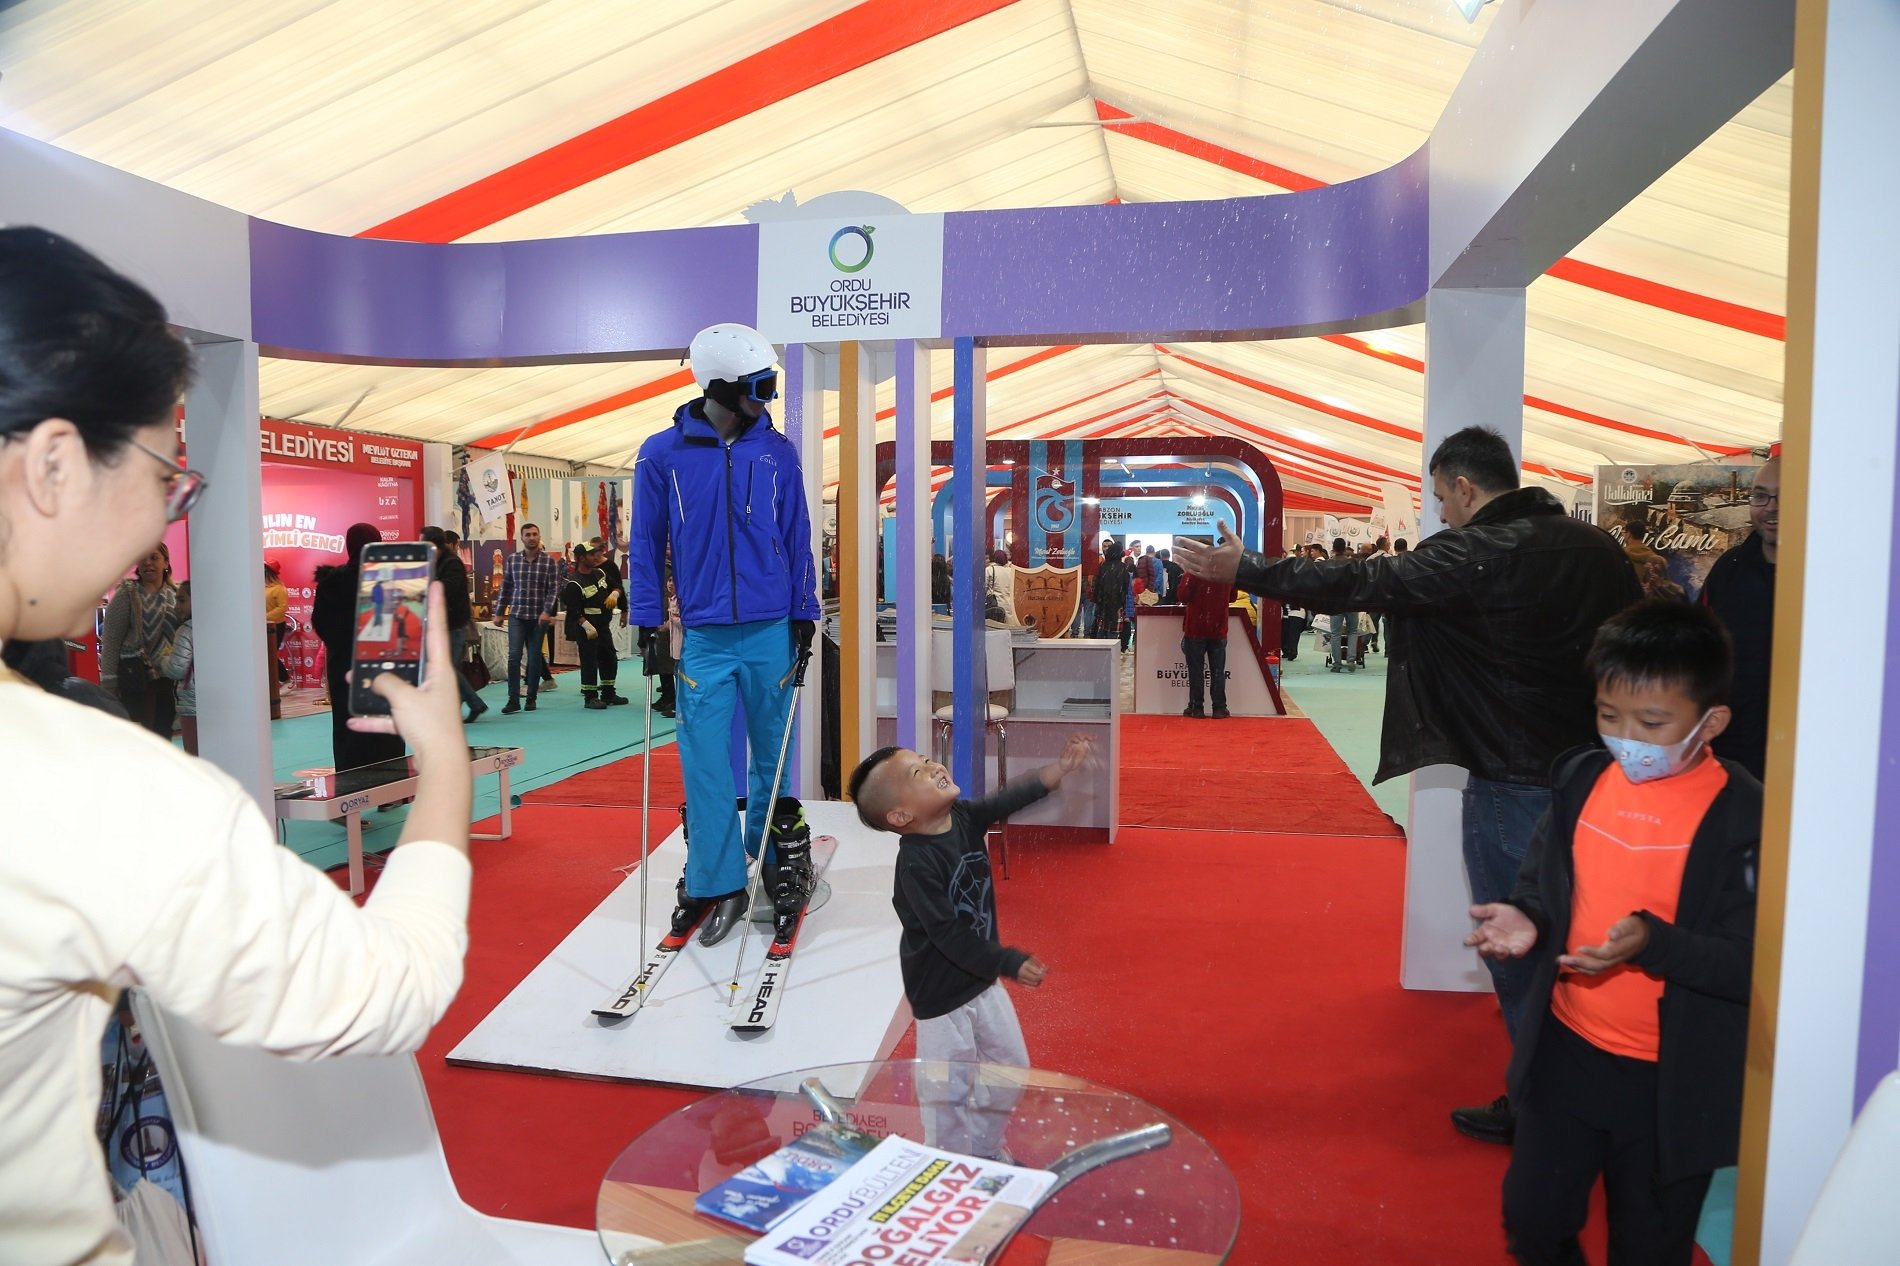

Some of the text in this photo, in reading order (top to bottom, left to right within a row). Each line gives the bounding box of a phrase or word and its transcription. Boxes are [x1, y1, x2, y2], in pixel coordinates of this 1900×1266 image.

[830, 279, 872, 292] ORDU
[790, 292, 911, 314] BÜYÜKŞEHİR
[811, 312, 889, 328] BELEDİYESİ
[260, 431, 354, 463] ELEDİYESİ
[263, 513, 317, 531] ILIN EN
[1100, 512, 1132, 520] KŞEHİR
[263, 529, 345, 554] YİMLİ GENCİ
[1157, 670, 1232, 680] BÜYÜER
[748, 972, 778, 1023] HEAD
[844, 1162, 983, 1266] OĞALGAZ
[893, 1195, 991, 1266] ELİYOR
